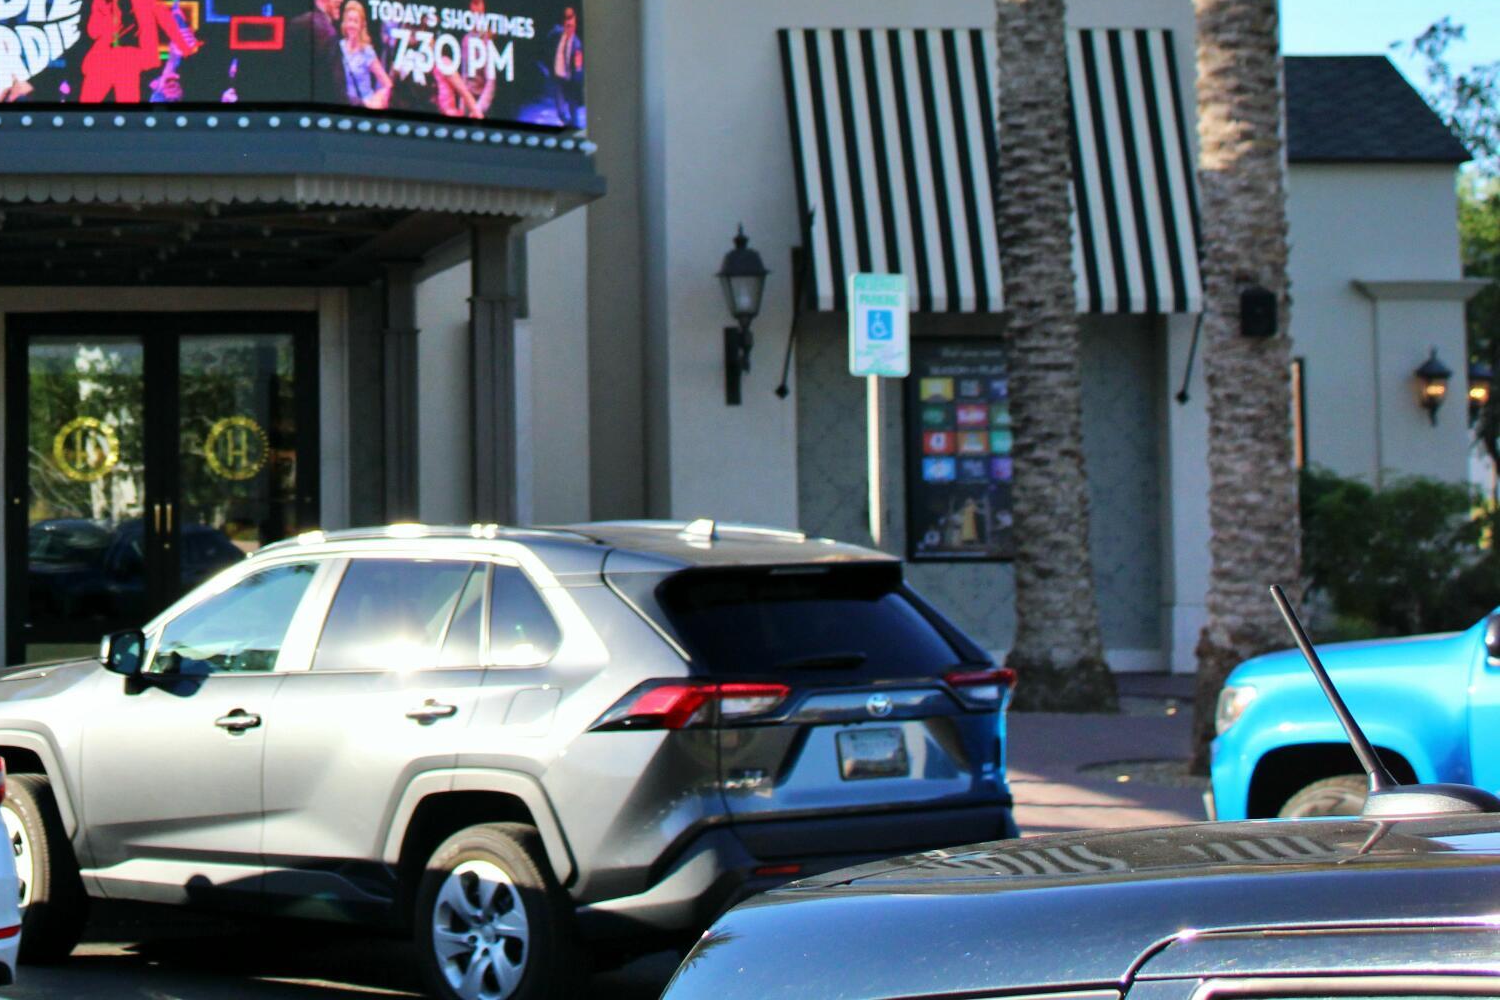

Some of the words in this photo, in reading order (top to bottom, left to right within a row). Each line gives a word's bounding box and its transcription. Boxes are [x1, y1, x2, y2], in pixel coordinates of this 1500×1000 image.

[441, 7, 535, 40] SHOWTIMES
[467, 37, 514, 82] PM
[228, 430, 248, 467] H
